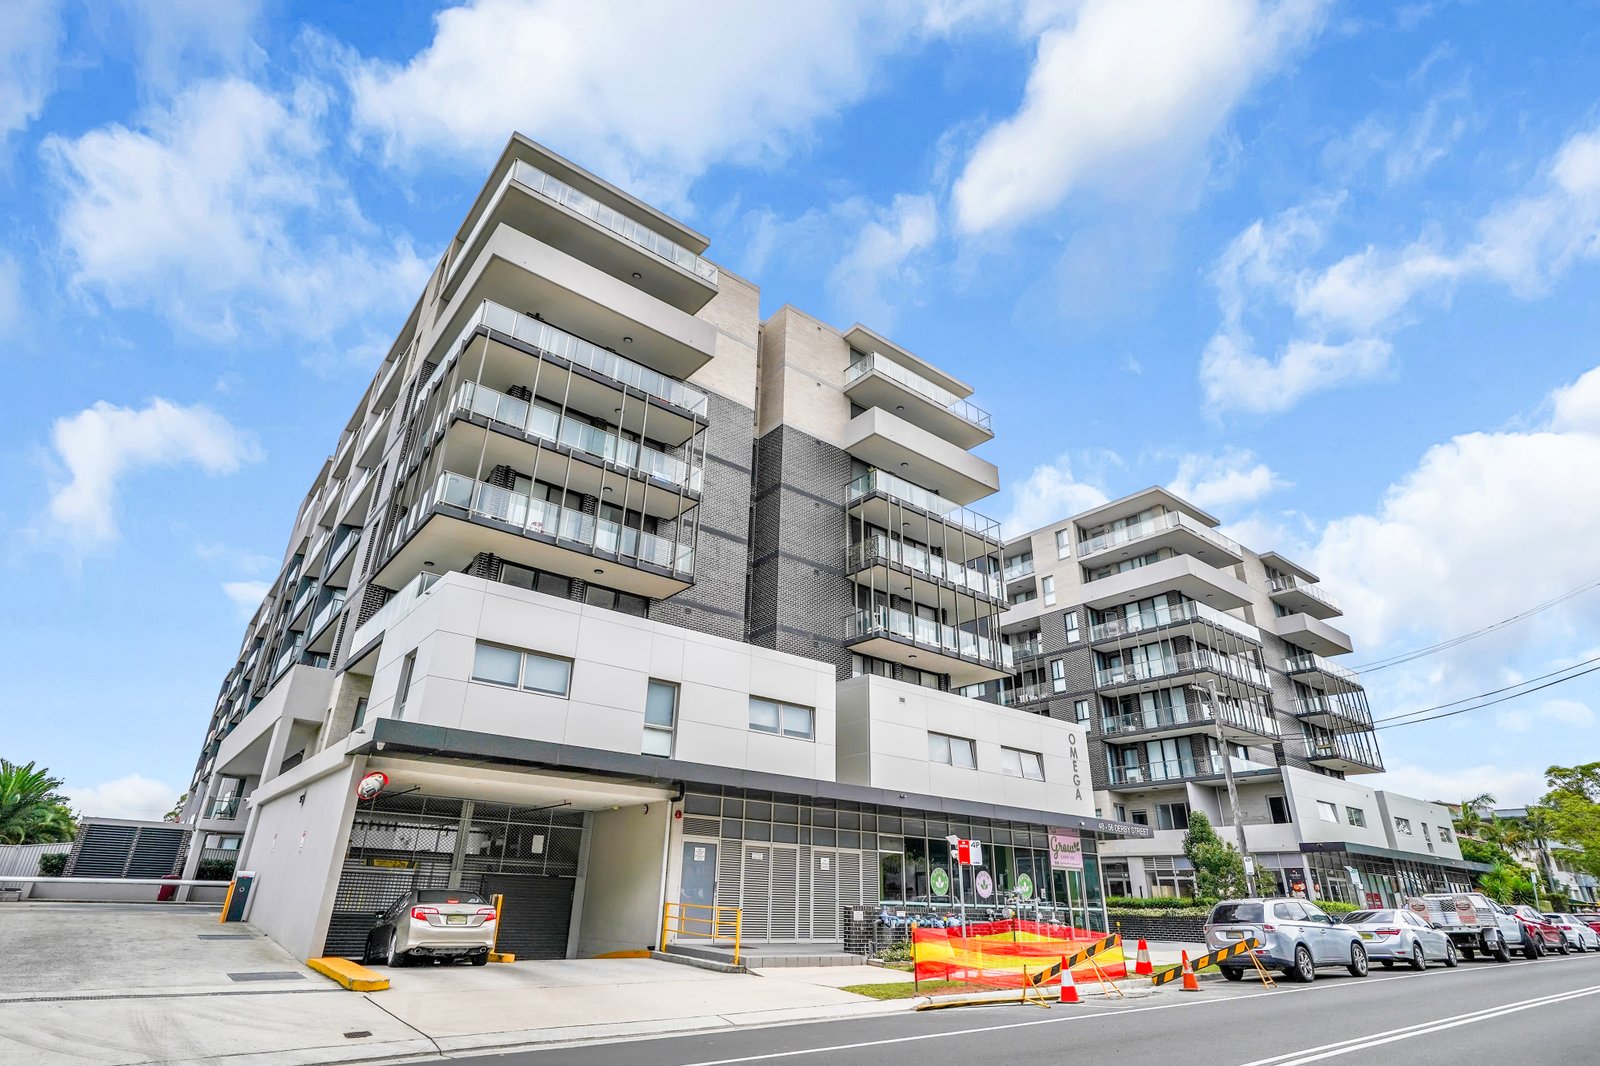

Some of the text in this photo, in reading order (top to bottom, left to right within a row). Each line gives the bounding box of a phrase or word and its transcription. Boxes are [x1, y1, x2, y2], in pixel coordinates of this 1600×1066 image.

[1068, 733, 1082, 800] OMEGA
[1099, 822, 1105, 830] 48
[1114, 824, 1131, 833] DERBY
[1131, 826, 1149, 836] STREET
